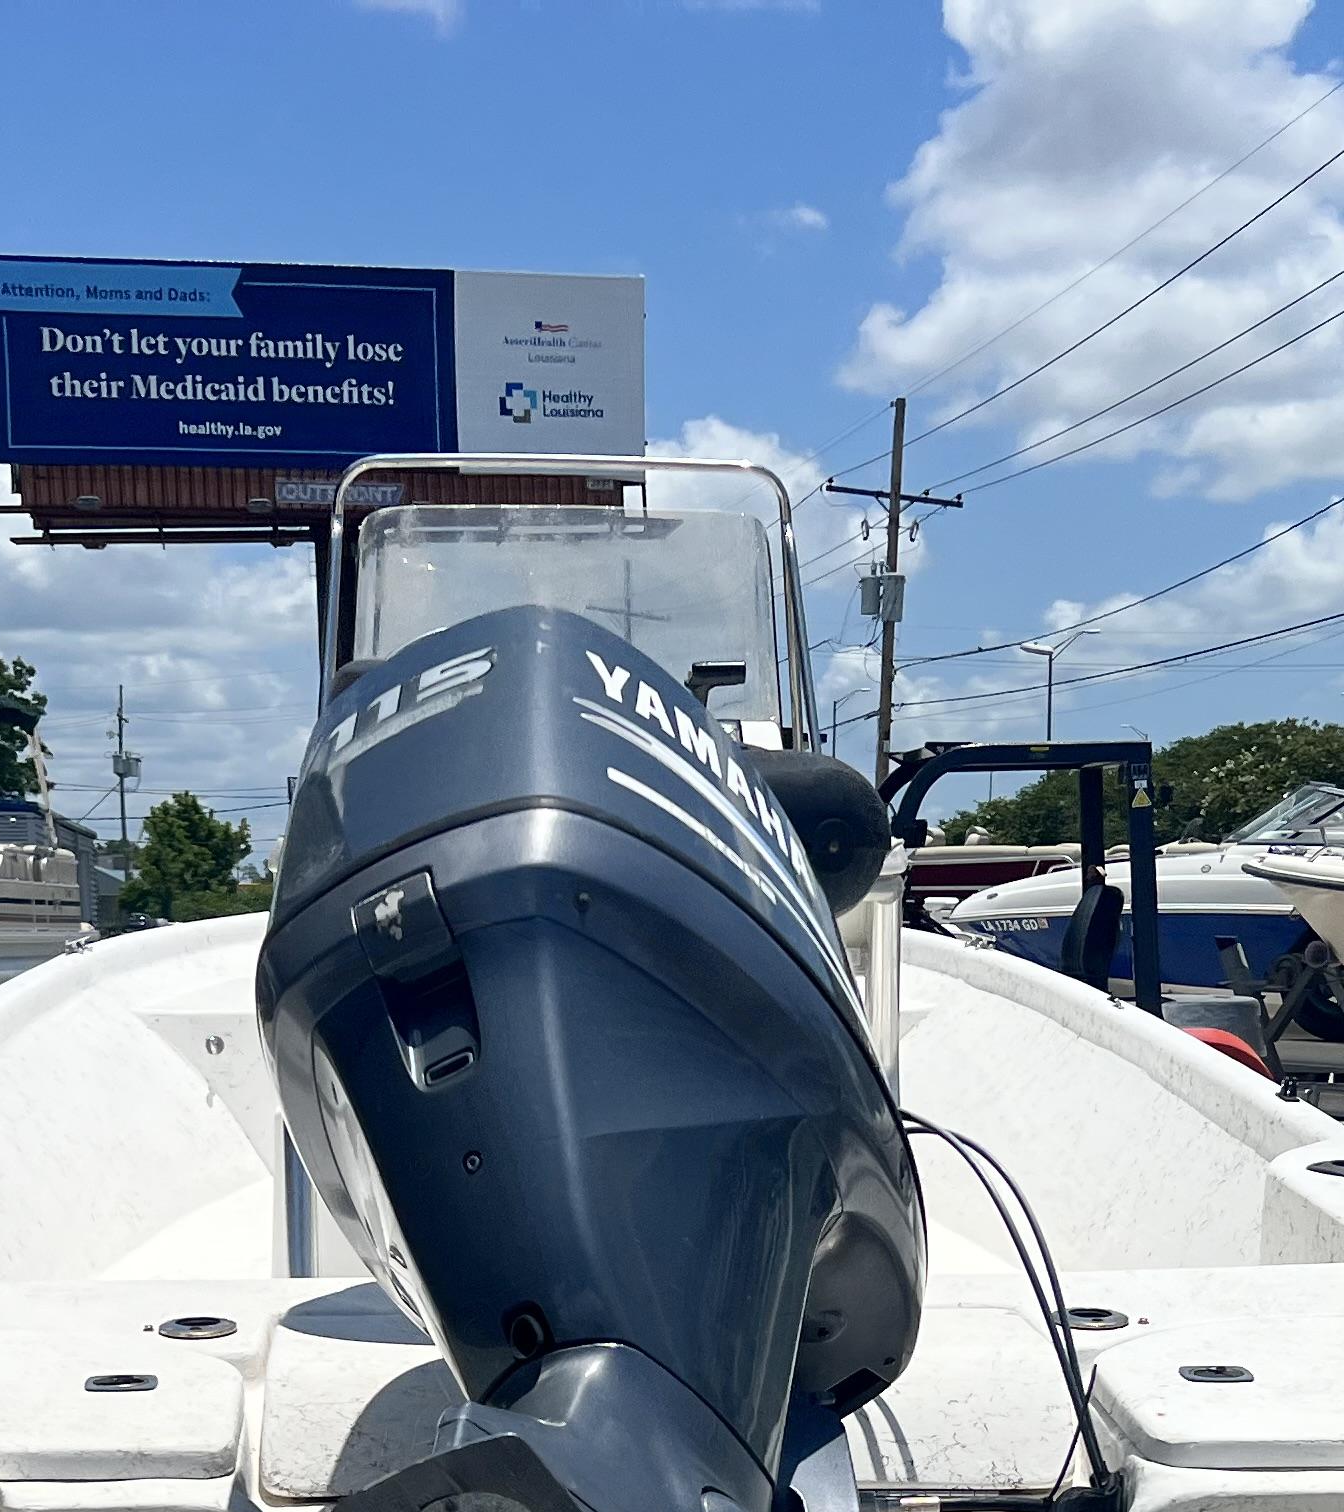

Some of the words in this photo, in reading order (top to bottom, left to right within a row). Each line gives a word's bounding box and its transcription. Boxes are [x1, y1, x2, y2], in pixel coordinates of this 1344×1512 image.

[0, 282, 81, 300] Attention,
[85, 285, 131, 300] Moms
[135, 286, 163, 301] and
[167, 288, 211, 302] Dads:
[39, 326, 125, 355] Don't
[129, 328, 169, 355] let
[174, 336, 244, 364] your
[249, 331, 341, 368] family
[346, 334, 404, 362] lose
[49, 371, 125, 398] their
[130, 374, 265, 401] Medicaid
[271, 376, 395, 405] benefits!
[542, 390, 594, 406] Healthy
[543, 405, 604, 418] Louisiana
[178, 421, 282, 439] healthy.la.gov
[328, 646, 494, 752] 115
[585, 650, 816, 897] YAMAHA
